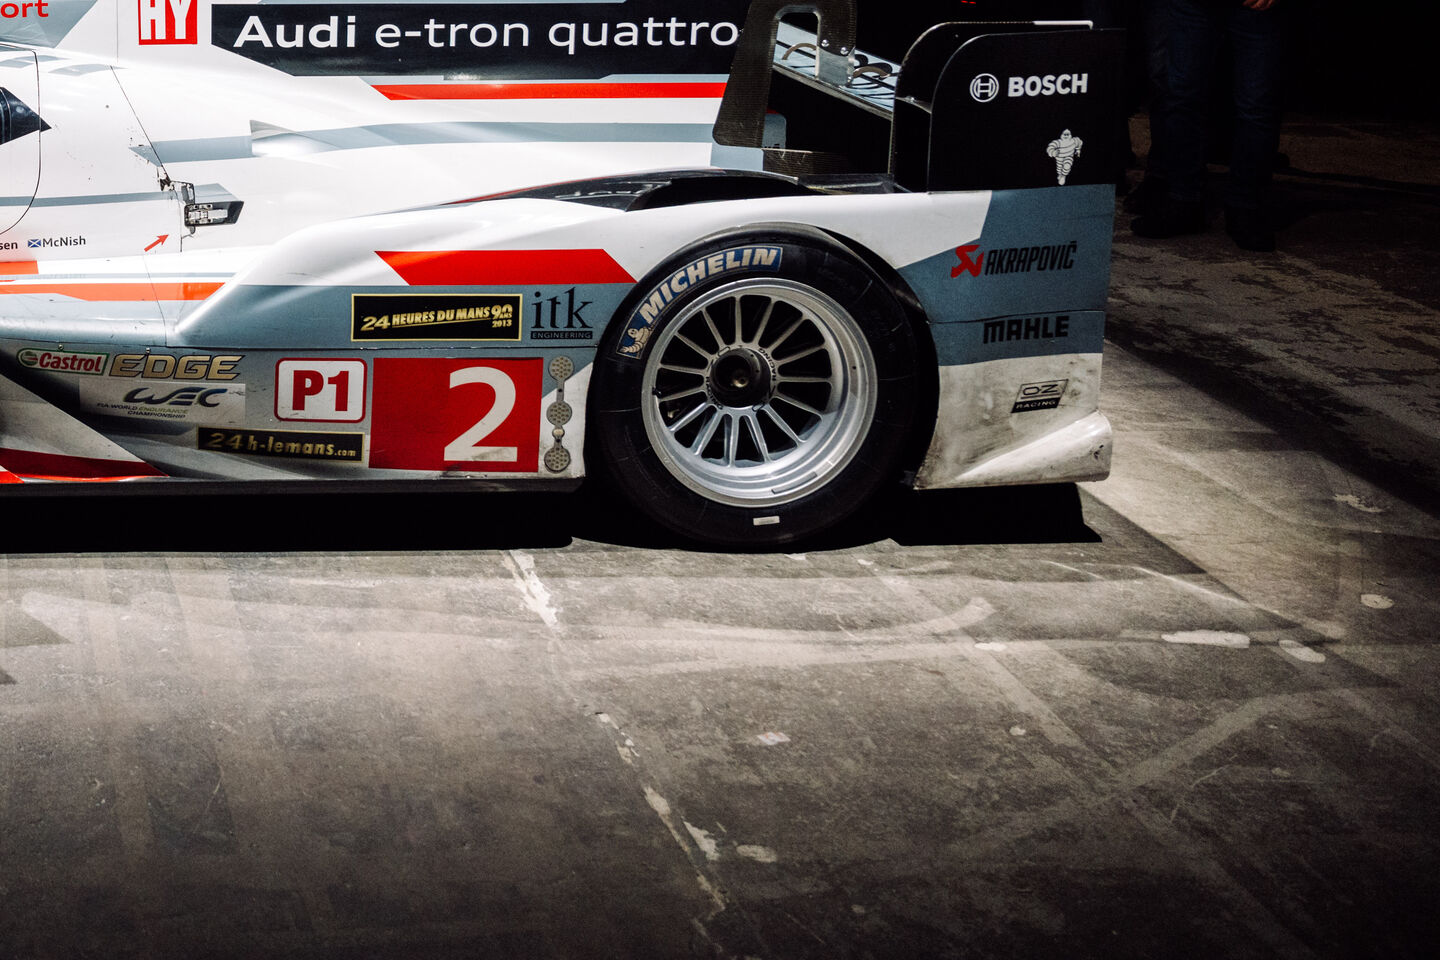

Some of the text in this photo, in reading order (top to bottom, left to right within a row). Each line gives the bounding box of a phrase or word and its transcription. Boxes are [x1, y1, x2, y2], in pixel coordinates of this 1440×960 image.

[234, 14, 739, 54] Audi e-tron quattro
[1007, 73, 1089, 98] BOSCH
[42, 236, 86, 248] McNish
[639, 247, 781, 325] MICHELIN
[360, 316, 391, 331] 24
[391, 310, 435, 327] HEURES
[436, 308, 455, 322] DU
[455, 306, 490, 320] MANS
[530, 286, 594, 329] itk
[492, 319, 513, 328] 2013
[532, 331, 592, 339] ENGINEERING
[983, 316, 1070, 344] MAHLE
[39, 352, 246, 380] Castrol EDGE
[122, 387, 228, 408] WEC
[292, 369, 350, 412] P1
[1022, 383, 1059, 396] OZ
[127, 410, 186, 419] CHAMPIONSHIP
[137, 406, 189, 414] ENDURANCE
[443, 365, 519, 463] 2
[1015, 400, 1057, 410] RACING
